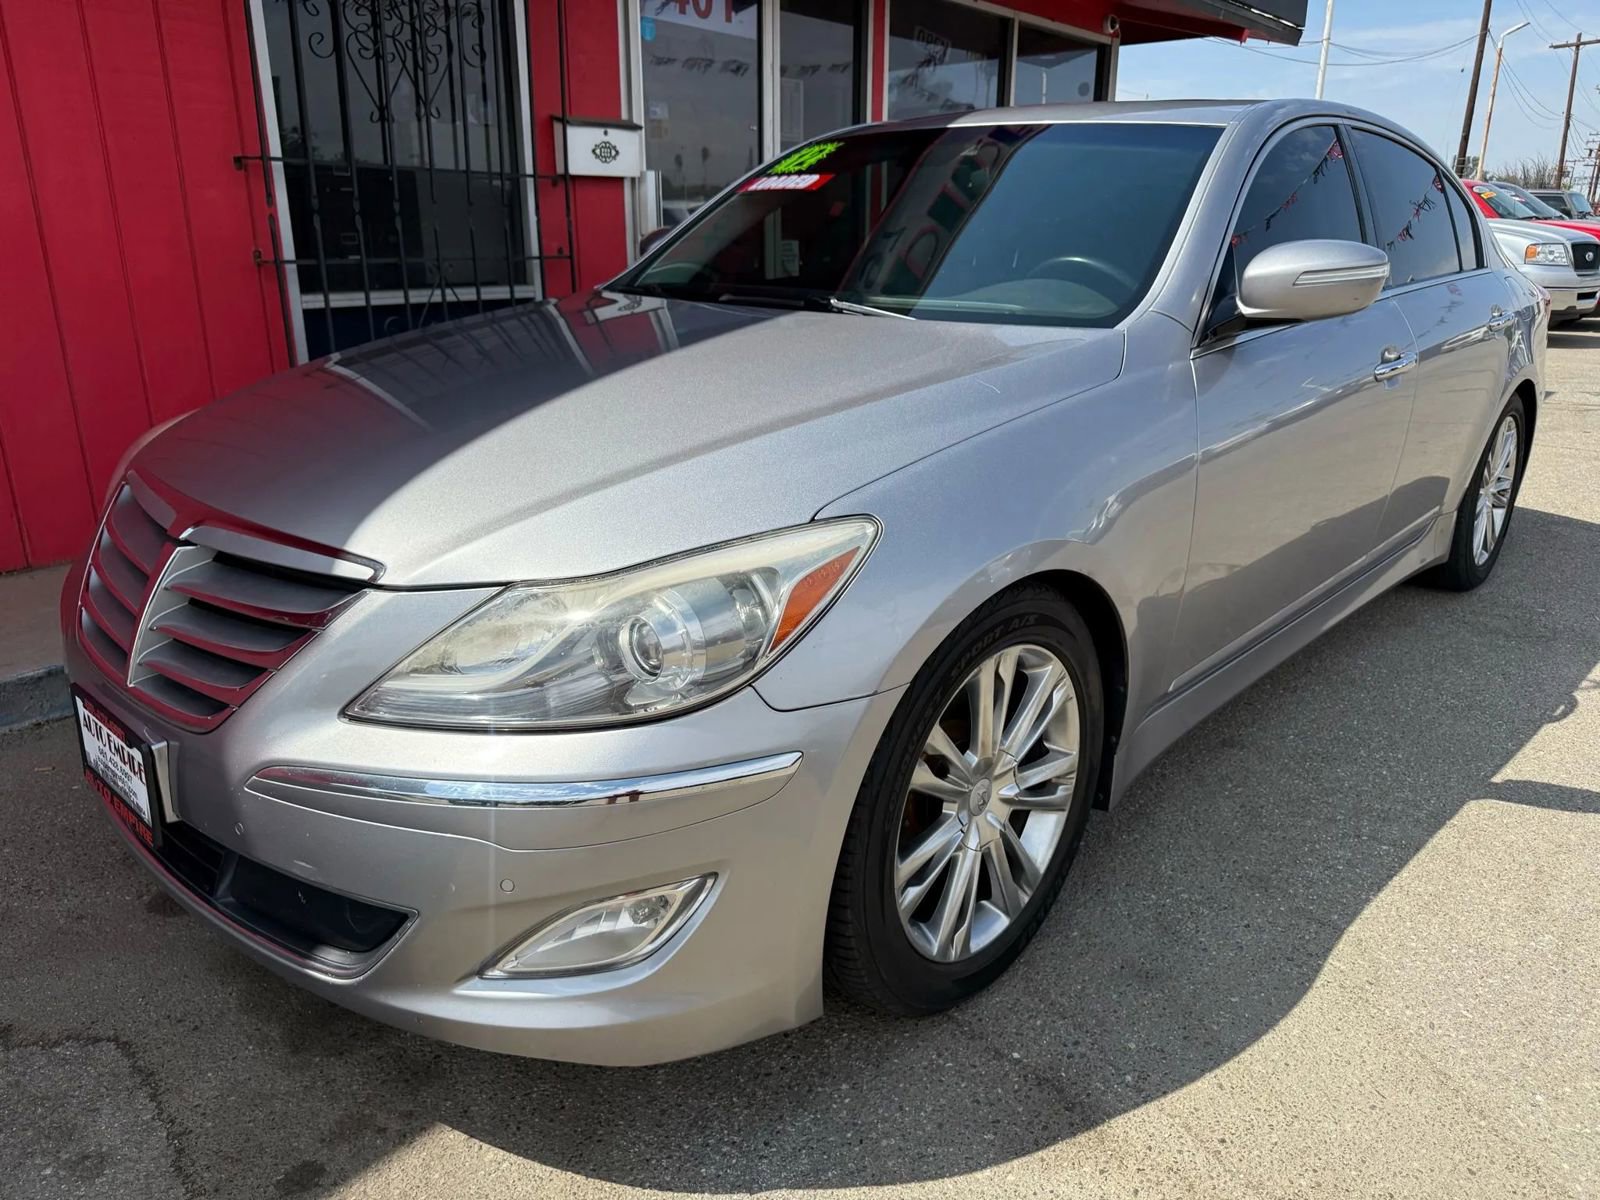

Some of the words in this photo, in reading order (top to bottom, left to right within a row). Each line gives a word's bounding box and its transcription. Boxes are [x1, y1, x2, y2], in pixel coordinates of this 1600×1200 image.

[83, 711, 107, 747] AUTO
[85, 768, 112, 801] AUTO
[112, 796, 153, 846] EMPIRE
